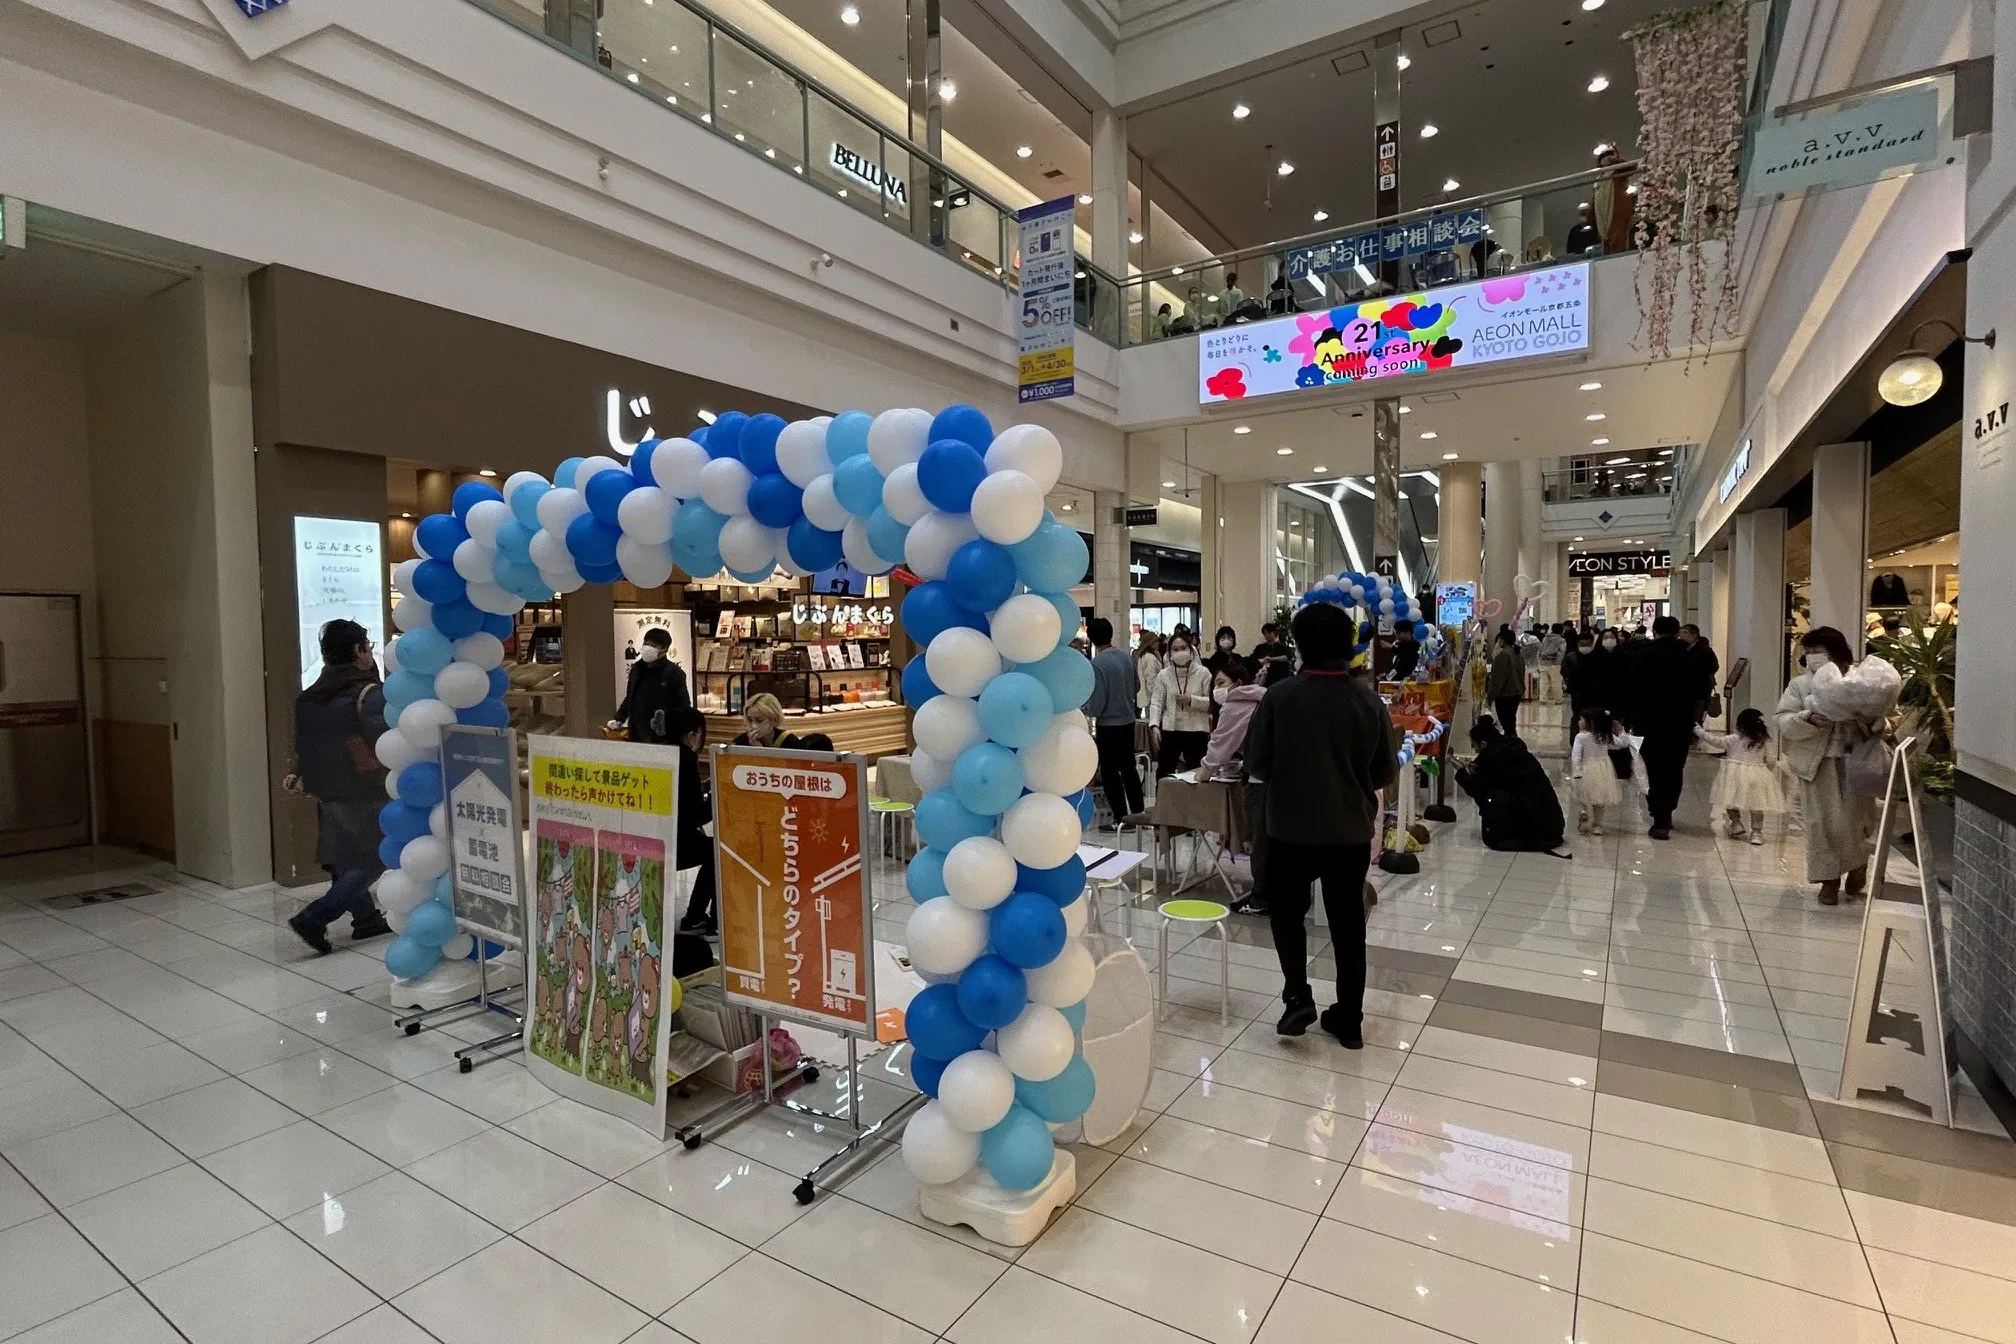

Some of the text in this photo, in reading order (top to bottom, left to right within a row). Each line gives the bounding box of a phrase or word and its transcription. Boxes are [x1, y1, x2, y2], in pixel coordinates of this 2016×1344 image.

[1803, 123, 1883, 153] a.v.v
[1766, 129, 1925, 175] noble standard
[834, 143, 907, 203] BELLUNA
[1289, 215, 1482, 275] 介護お仕事相談会
[1501, 300, 1582, 319] イオンモール京都五条
[1206, 334, 1250, 348] 色とりどりに
[1472, 313, 1582, 343] AEON MALL
[1321, 338, 1431, 366] Anniversary
[1472, 329, 1582, 359] KYOTO GOJO
[1325, 357, 1419, 381] coming soon
[1974, 402, 2009, 440] a.v.v
[303, 540, 374, 554] じぶんまくら
[1618, 555, 1671, 571] STYLE
[792, 603, 894, 625] じぶんまくら
[548, 763, 650, 790] 間違い探して景品ゲット
[746, 771, 833, 793] おうちの屋根は
[456, 800, 508, 828] 太陽光発電
[468, 837, 499, 863] 蓄電池
